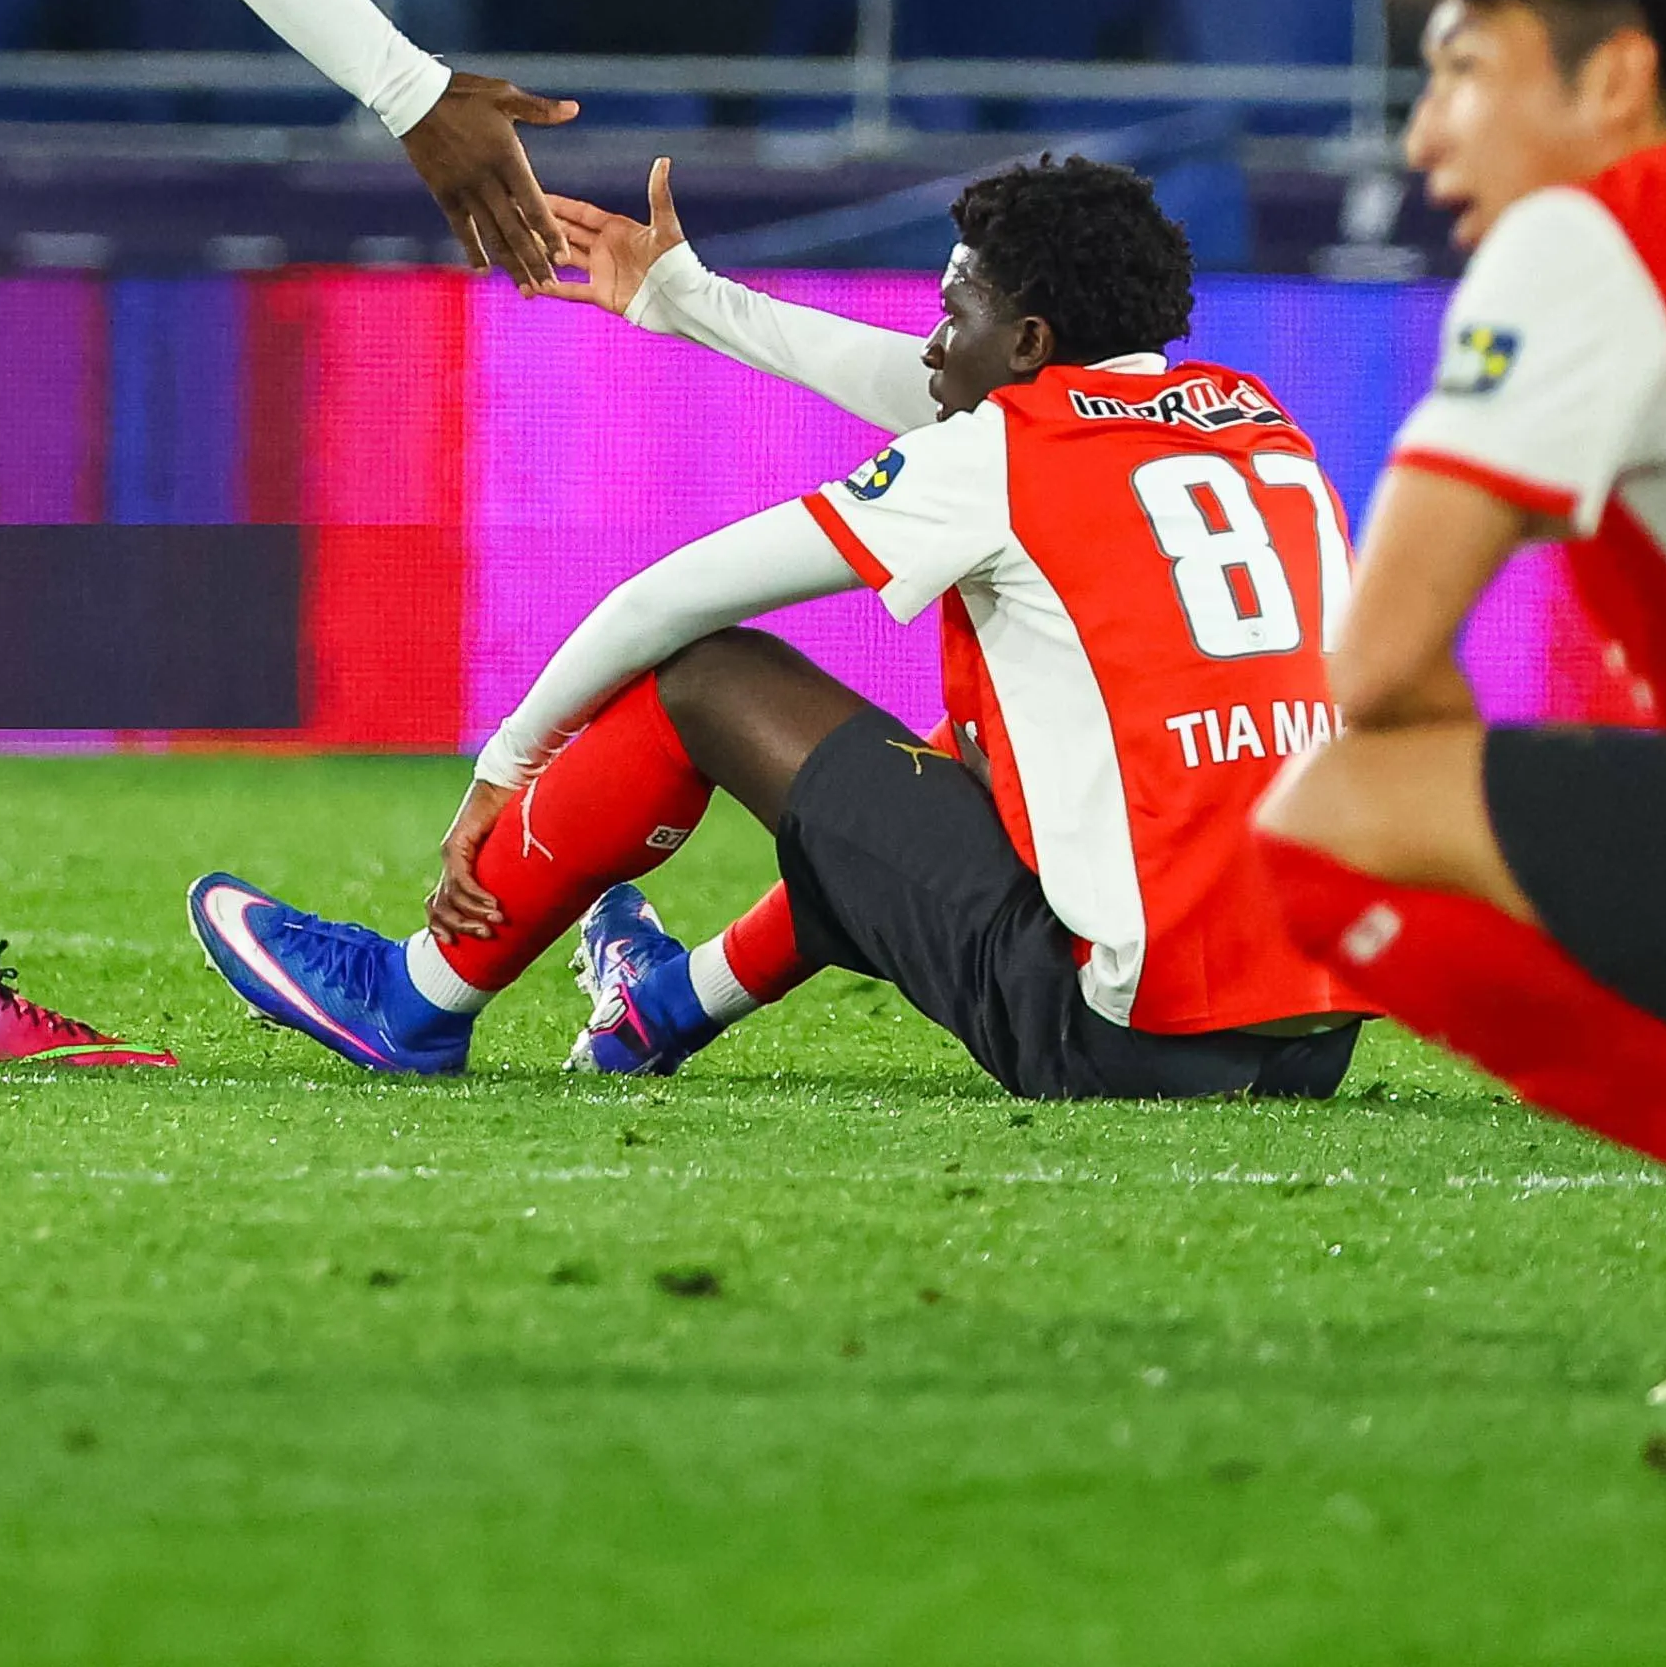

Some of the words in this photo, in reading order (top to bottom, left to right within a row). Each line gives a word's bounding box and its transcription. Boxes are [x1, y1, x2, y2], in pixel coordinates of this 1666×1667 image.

[1130, 449, 1352, 658] 87
[1165, 704, 1266, 768] TIA
[652, 828, 685, 846] 87
